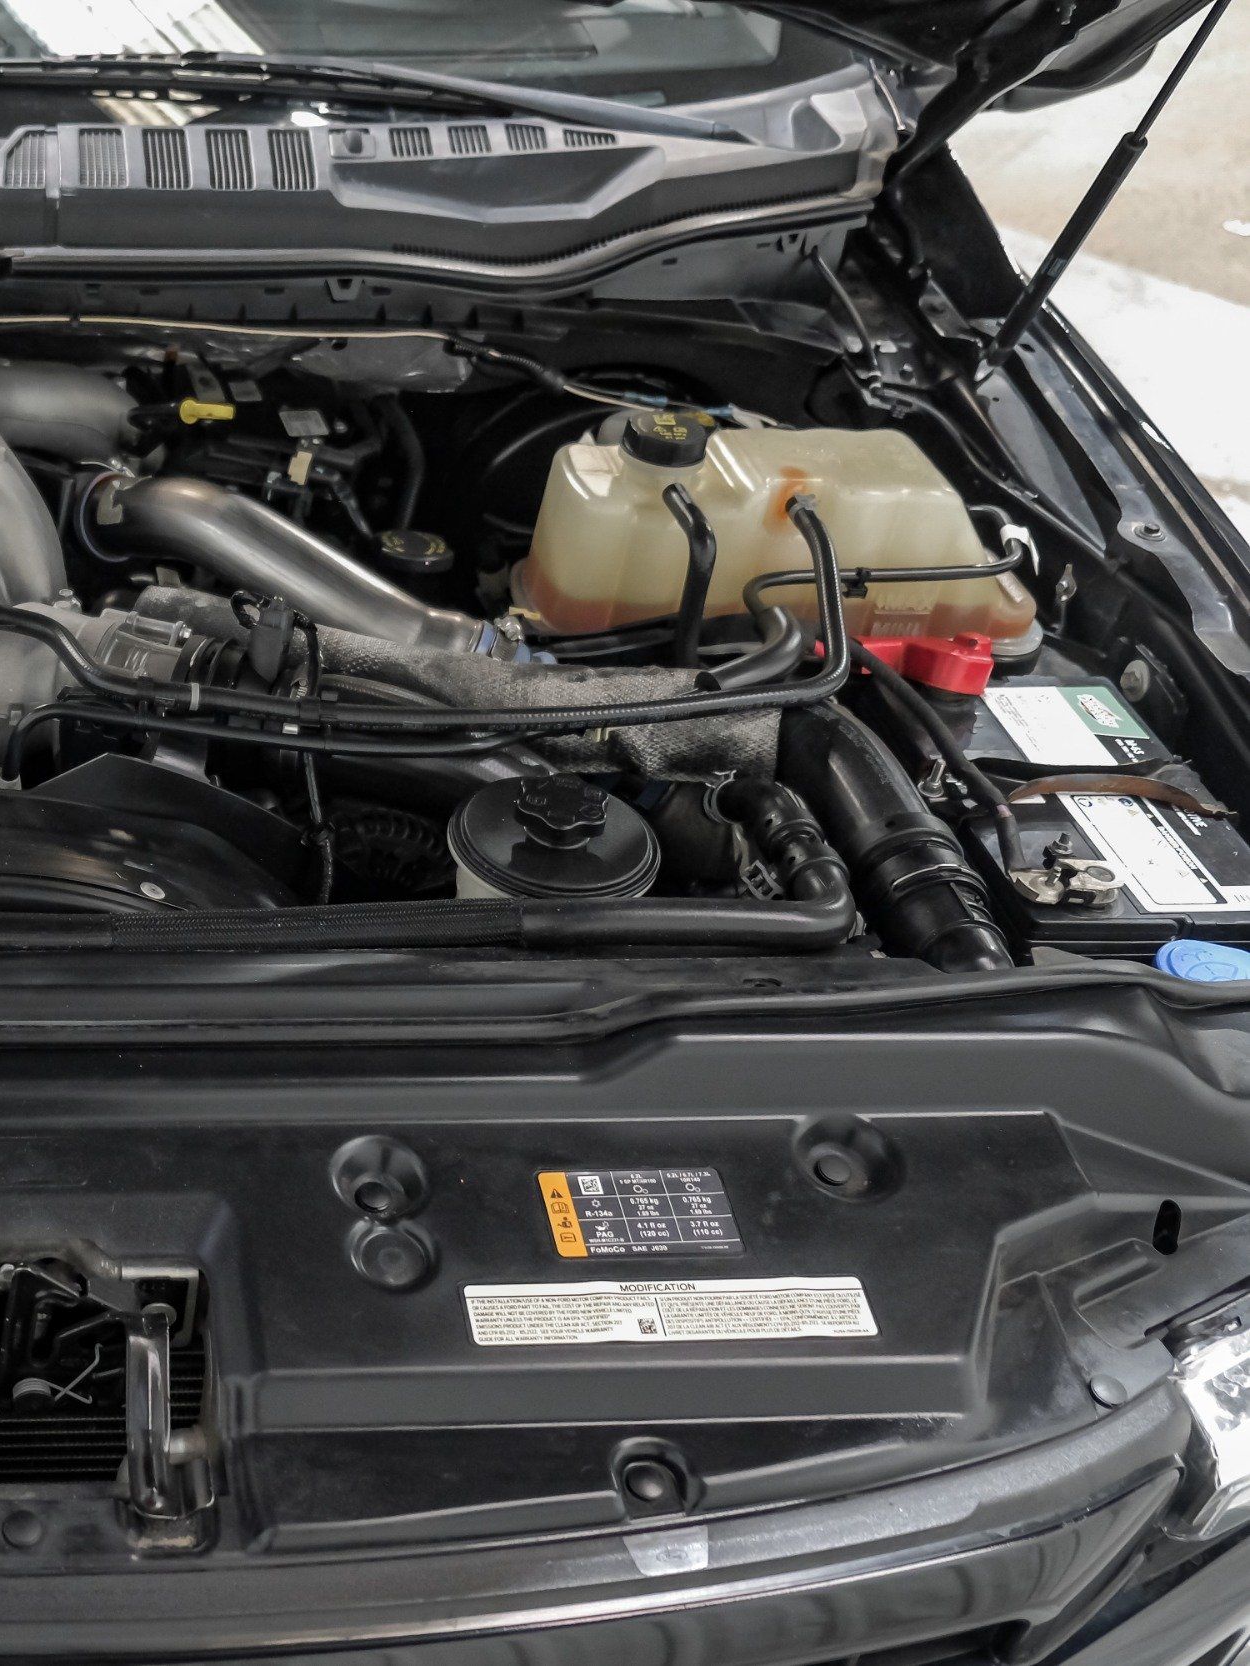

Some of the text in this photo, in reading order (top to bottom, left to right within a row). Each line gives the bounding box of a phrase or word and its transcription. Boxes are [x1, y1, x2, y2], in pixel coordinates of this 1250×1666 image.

[629, 1197, 660, 1206] 0.765 kg
[702, 1196, 712, 1204] kg
[640, 1230, 657, 1238] (120
[692, 1229, 709, 1237] (110
[590, 1246, 626, 1254] FoMoCo
[619, 1283, 697, 1292] MODIFICATION
